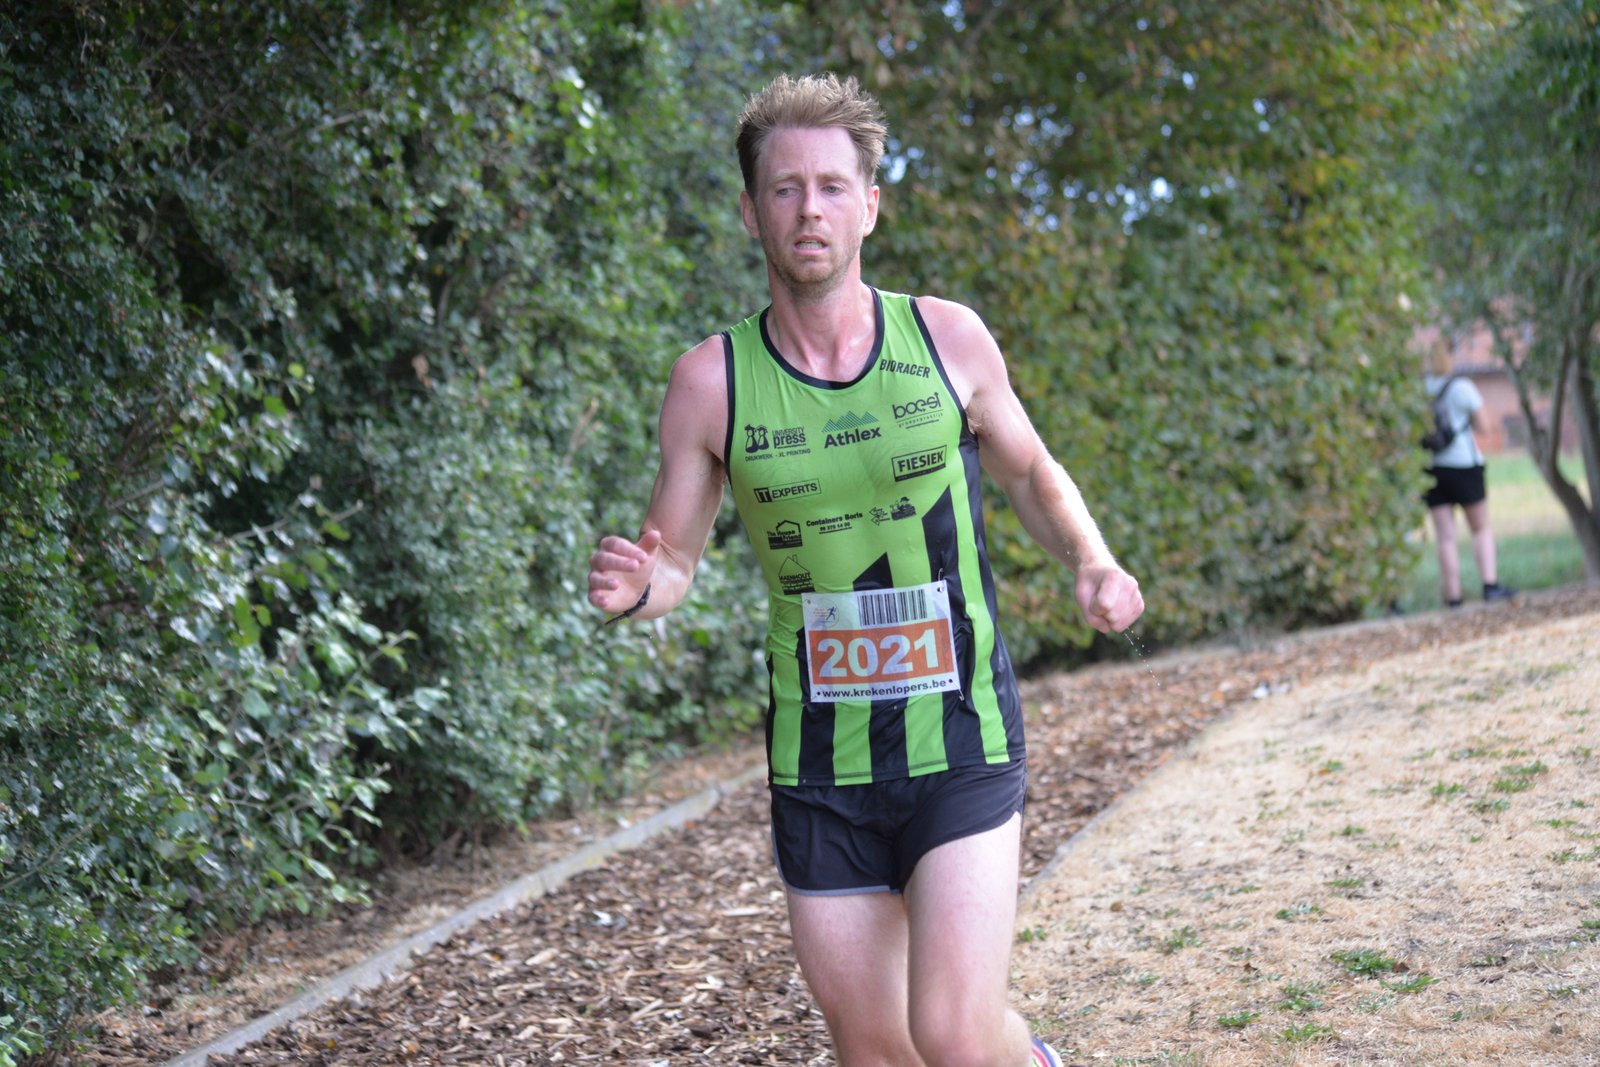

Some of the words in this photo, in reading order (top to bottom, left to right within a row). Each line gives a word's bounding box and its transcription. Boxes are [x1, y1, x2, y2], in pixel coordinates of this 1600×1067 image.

[879, 359, 931, 378] BIORACER
[773, 433, 806, 449] press
[824, 427, 881, 449] Athlex
[786, 448, 811, 457] PRINTING
[897, 451, 944, 472] FIESIEK
[772, 483, 818, 499] EXPERTS
[806, 516, 843, 527] Containers
[844, 512, 863, 521] Boris
[817, 628, 939, 678] 2021
[822, 680, 947, 698] www.krekenlopers.be
